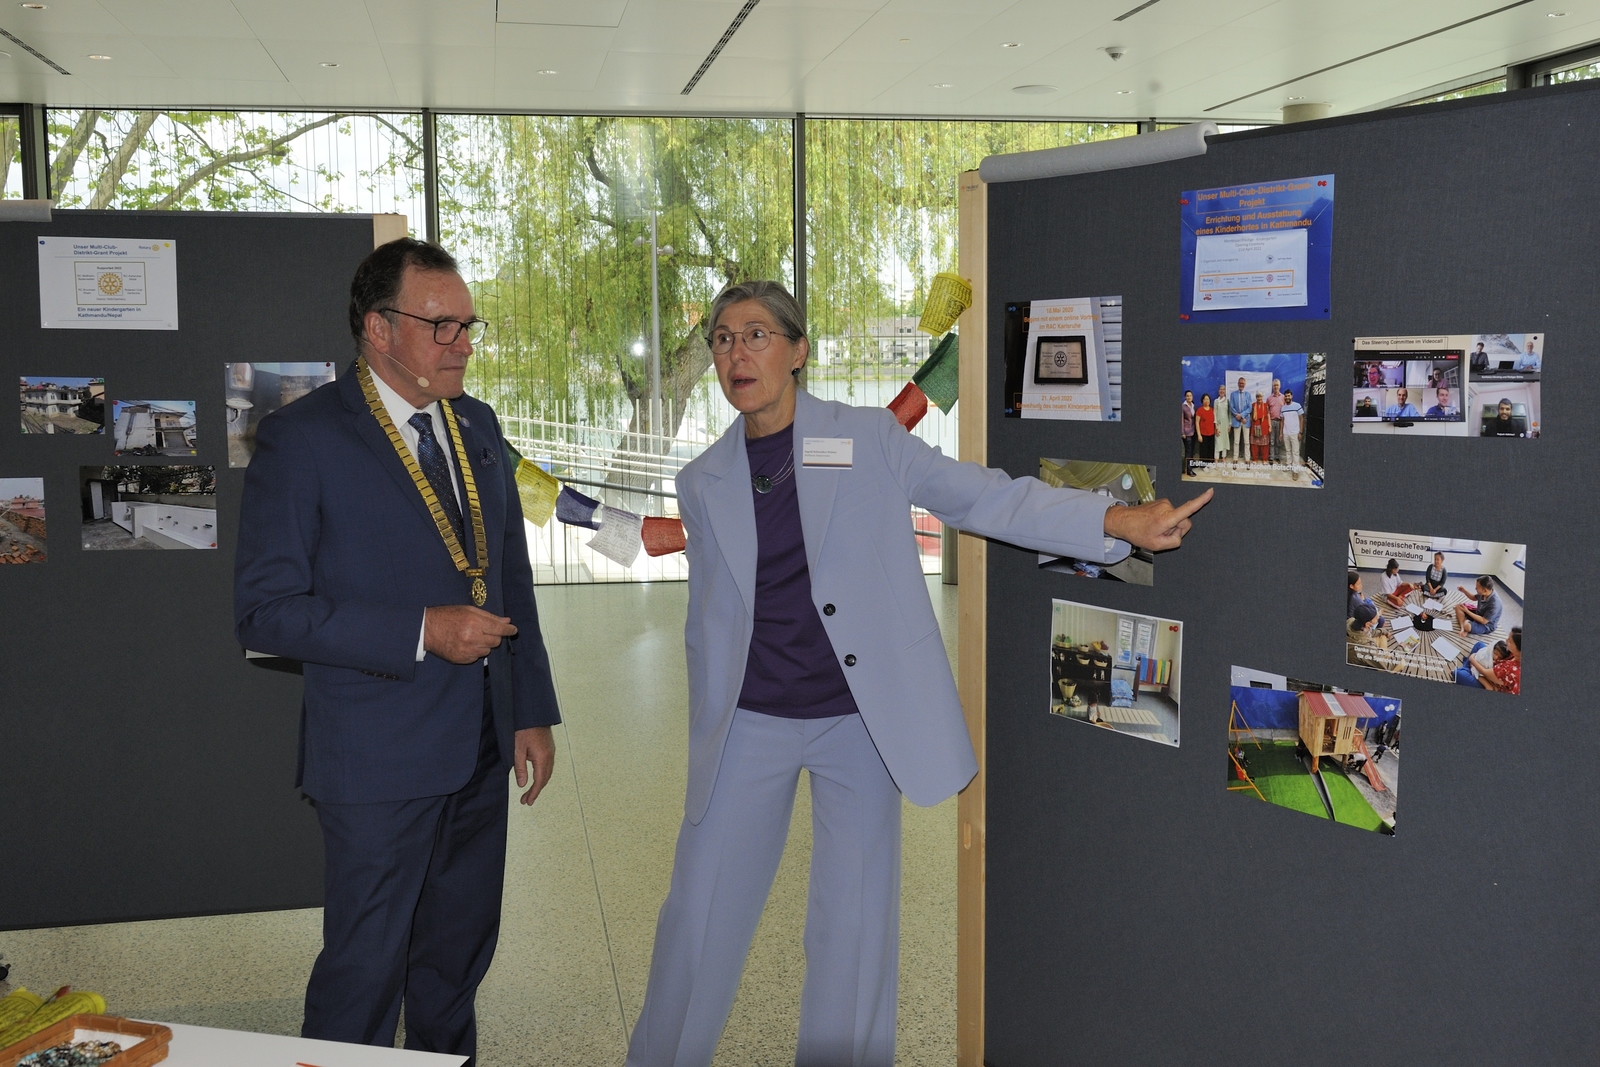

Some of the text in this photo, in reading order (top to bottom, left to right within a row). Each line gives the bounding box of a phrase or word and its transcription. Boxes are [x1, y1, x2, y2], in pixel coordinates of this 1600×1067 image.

[1220, 182, 1311, 198] Multi-Club-Distrikt-Grant-
[1239, 198, 1265, 207] Projekt
[1206, 210, 1302, 224] Errichtung und Ausstattung
[1215, 223, 1259, 233] Kinderhortes
[1270, 218, 1312, 229] Kathmandu
[1385, 550, 1423, 561] Ausbildung
[1354, 645, 1369, 653] Danke
